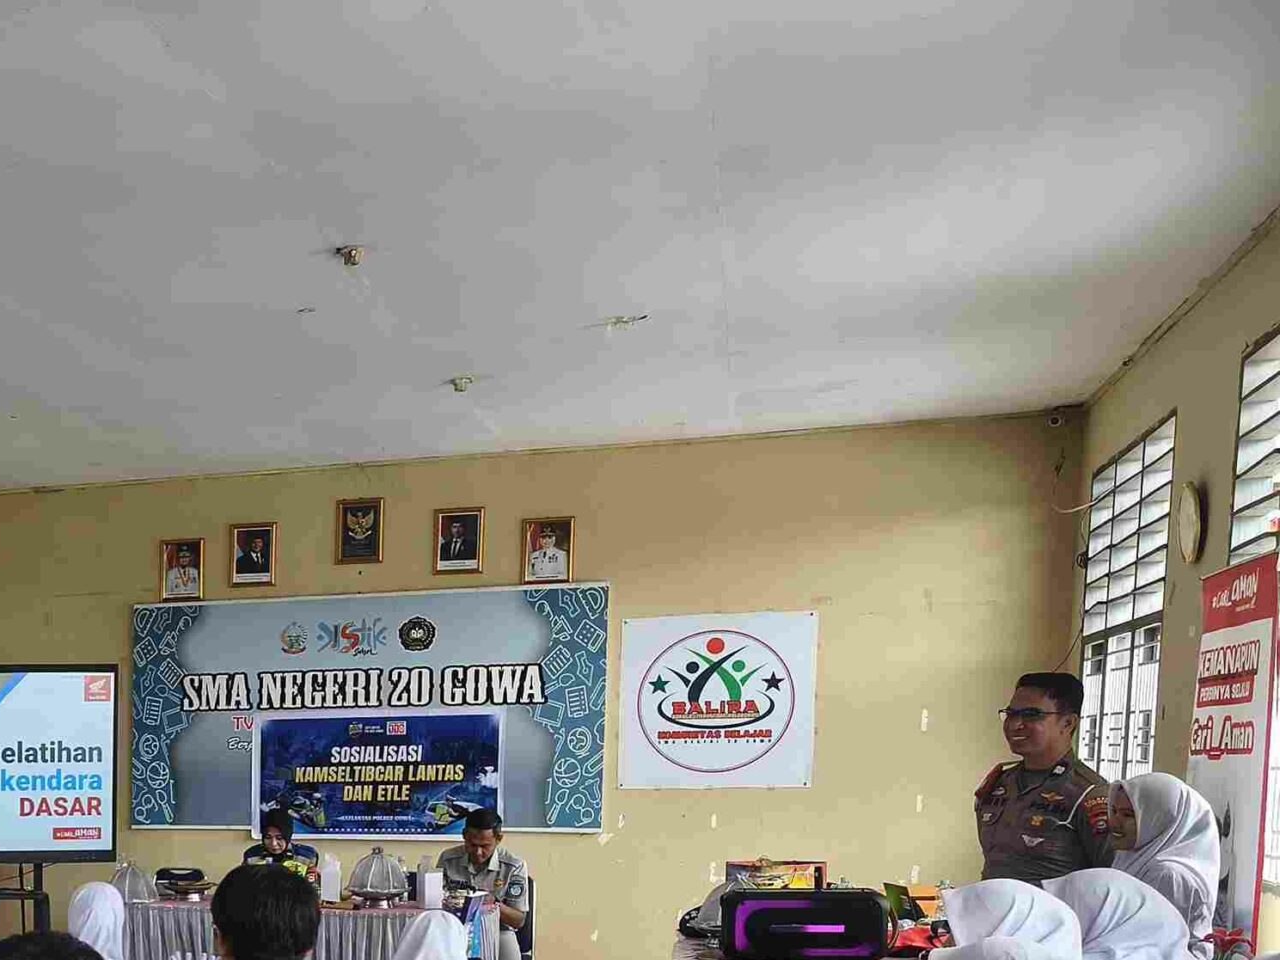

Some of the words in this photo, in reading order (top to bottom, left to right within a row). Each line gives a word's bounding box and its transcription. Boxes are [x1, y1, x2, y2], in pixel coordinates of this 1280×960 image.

[183, 674, 250, 710] SMA
[260, 669, 380, 708] NEGERI
[390, 668, 431, 706] 20
[443, 665, 545, 705] GOWA
[671, 700, 760, 714] BALIRA
[331, 745, 423, 763] SOSIALISASI
[295, 765, 404, 783] KAMSELTIBCAR
[407, 764, 465, 782] LANTAS
[343, 785, 372, 801] DAN
[376, 784, 411, 801] ETLE
[19, 797, 102, 817] DASAR
